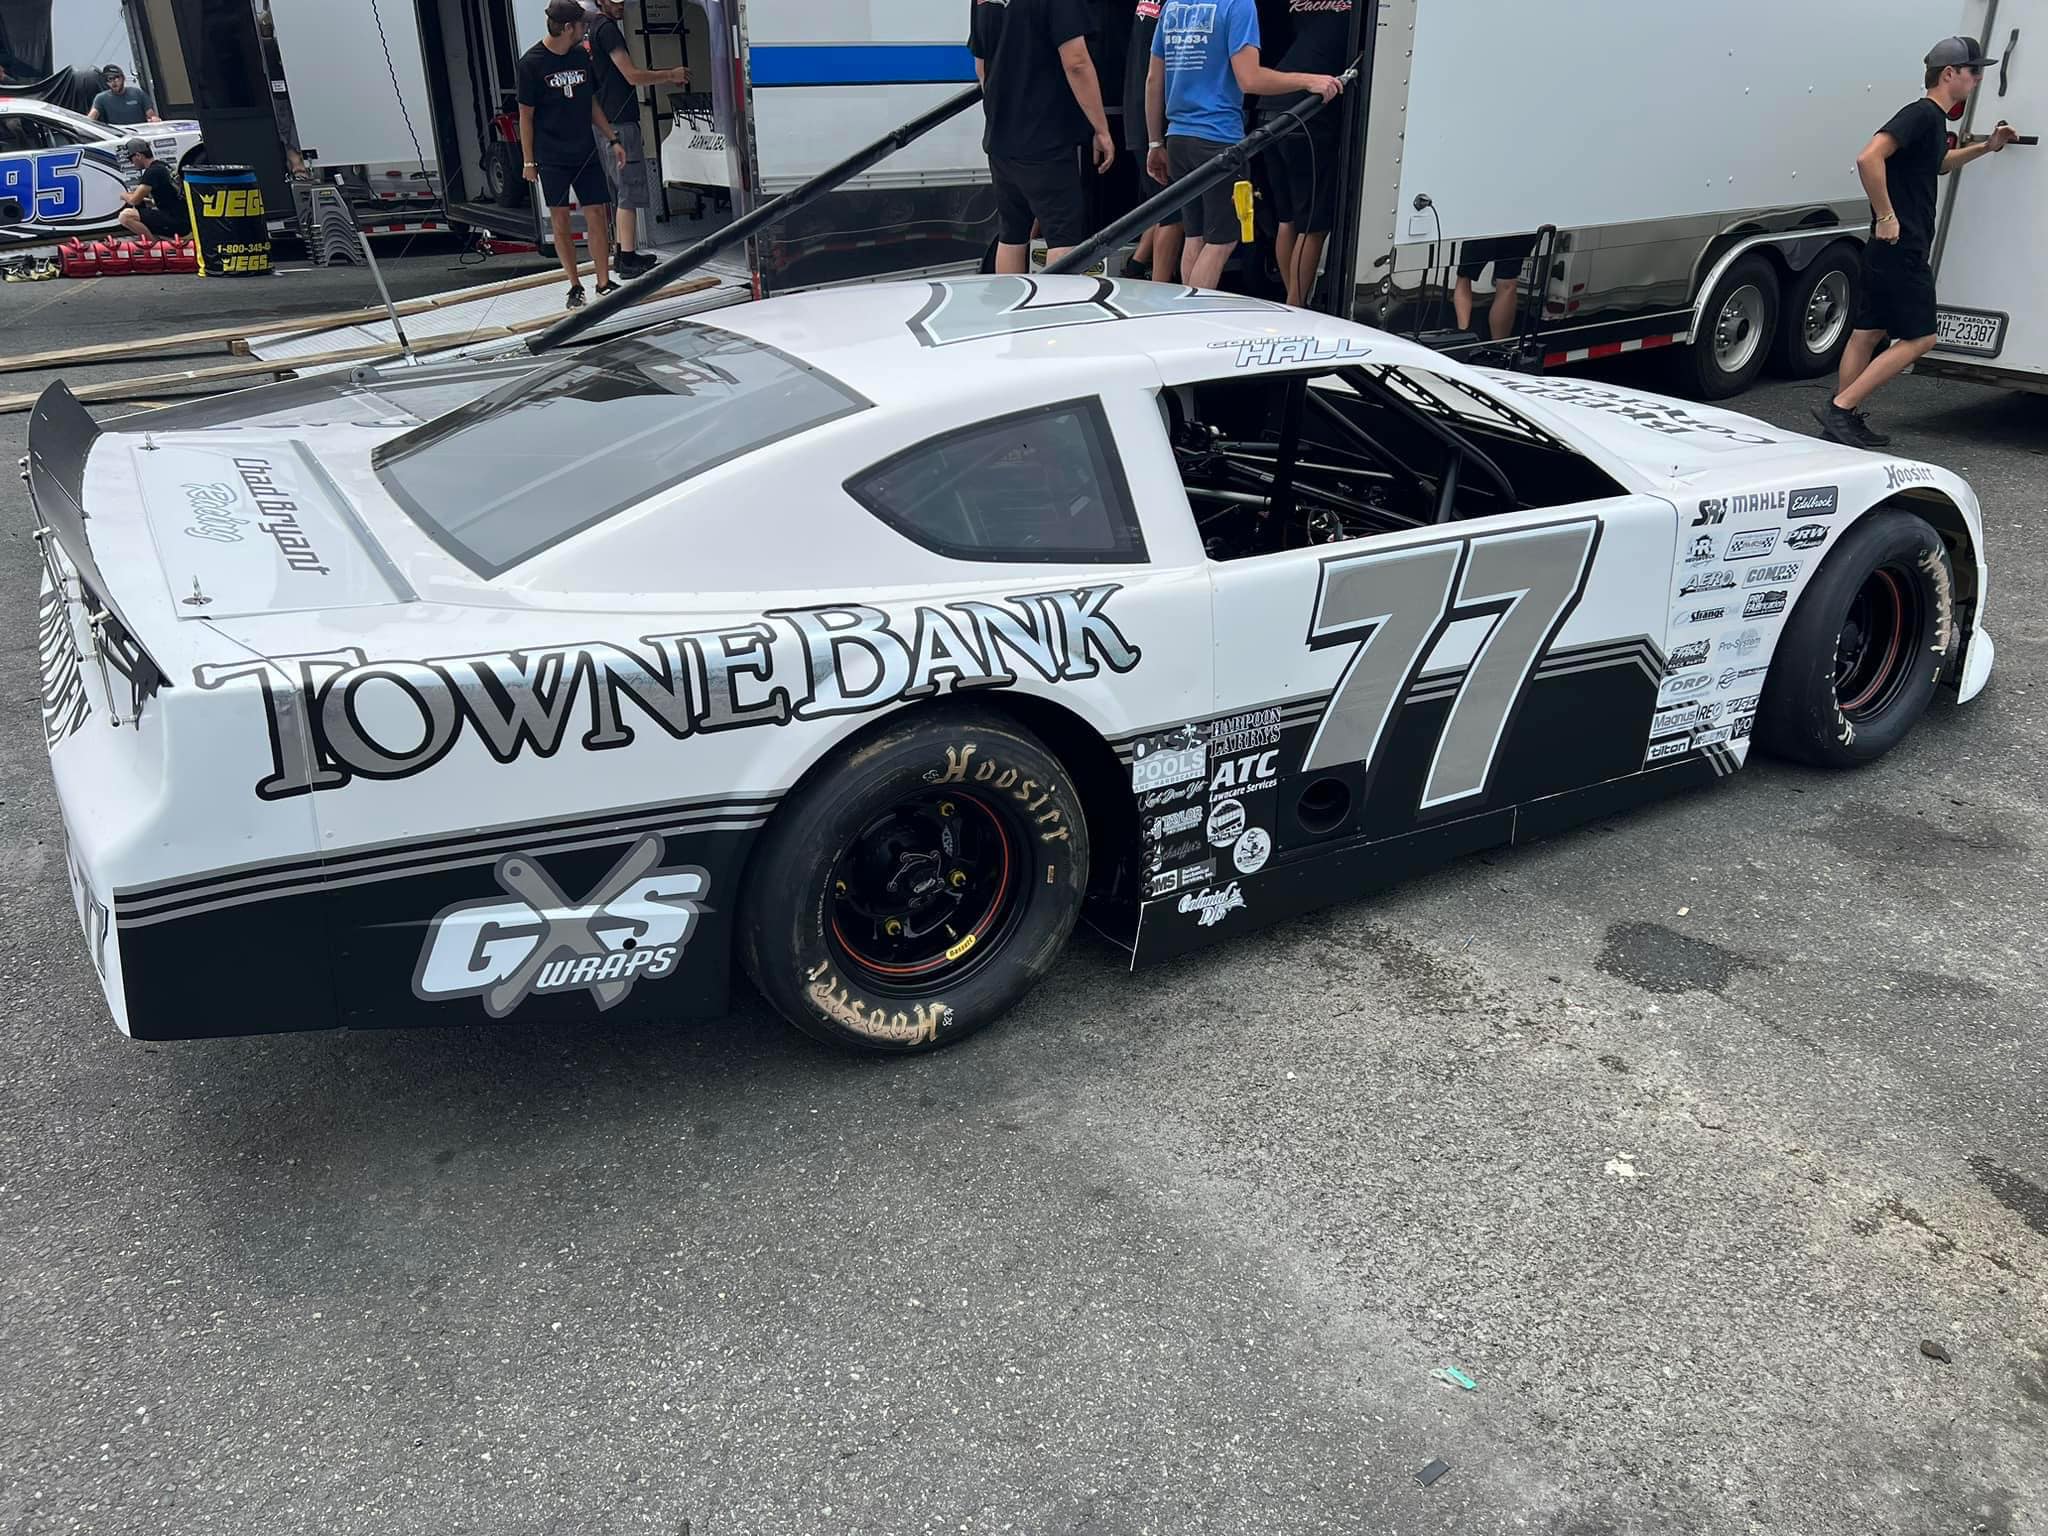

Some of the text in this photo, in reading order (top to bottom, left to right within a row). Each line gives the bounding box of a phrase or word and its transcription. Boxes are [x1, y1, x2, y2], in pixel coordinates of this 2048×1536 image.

[0, 150, 84, 223] 95
[203, 189, 265, 217] JEG
[1235, 338, 1372, 367] HALL
[180, 482, 251, 543] Racing
[232, 457, 331, 575] Chad Bryant
[1731, 491, 1786, 514] MAHLE
[1791, 495, 1834, 511] Edelbrock
[1685, 570, 1735, 587] AERO
[1746, 565, 1787, 583] COMP
[1301, 515, 1605, 814] 77
[1670, 675, 1709, 692] DRP
[1210, 706, 1281, 738] HARPOON
[1654, 711, 1696, 728] Magnus
[1651, 742, 1686, 757] tilton
[1135, 751, 1204, 783] POOLS
[1210, 749, 1279, 791] ATC
[934, 744, 1070, 841] Hoosier
[1246, 778, 1278, 793] Services
[536, 947, 677, 988] WRAPS
